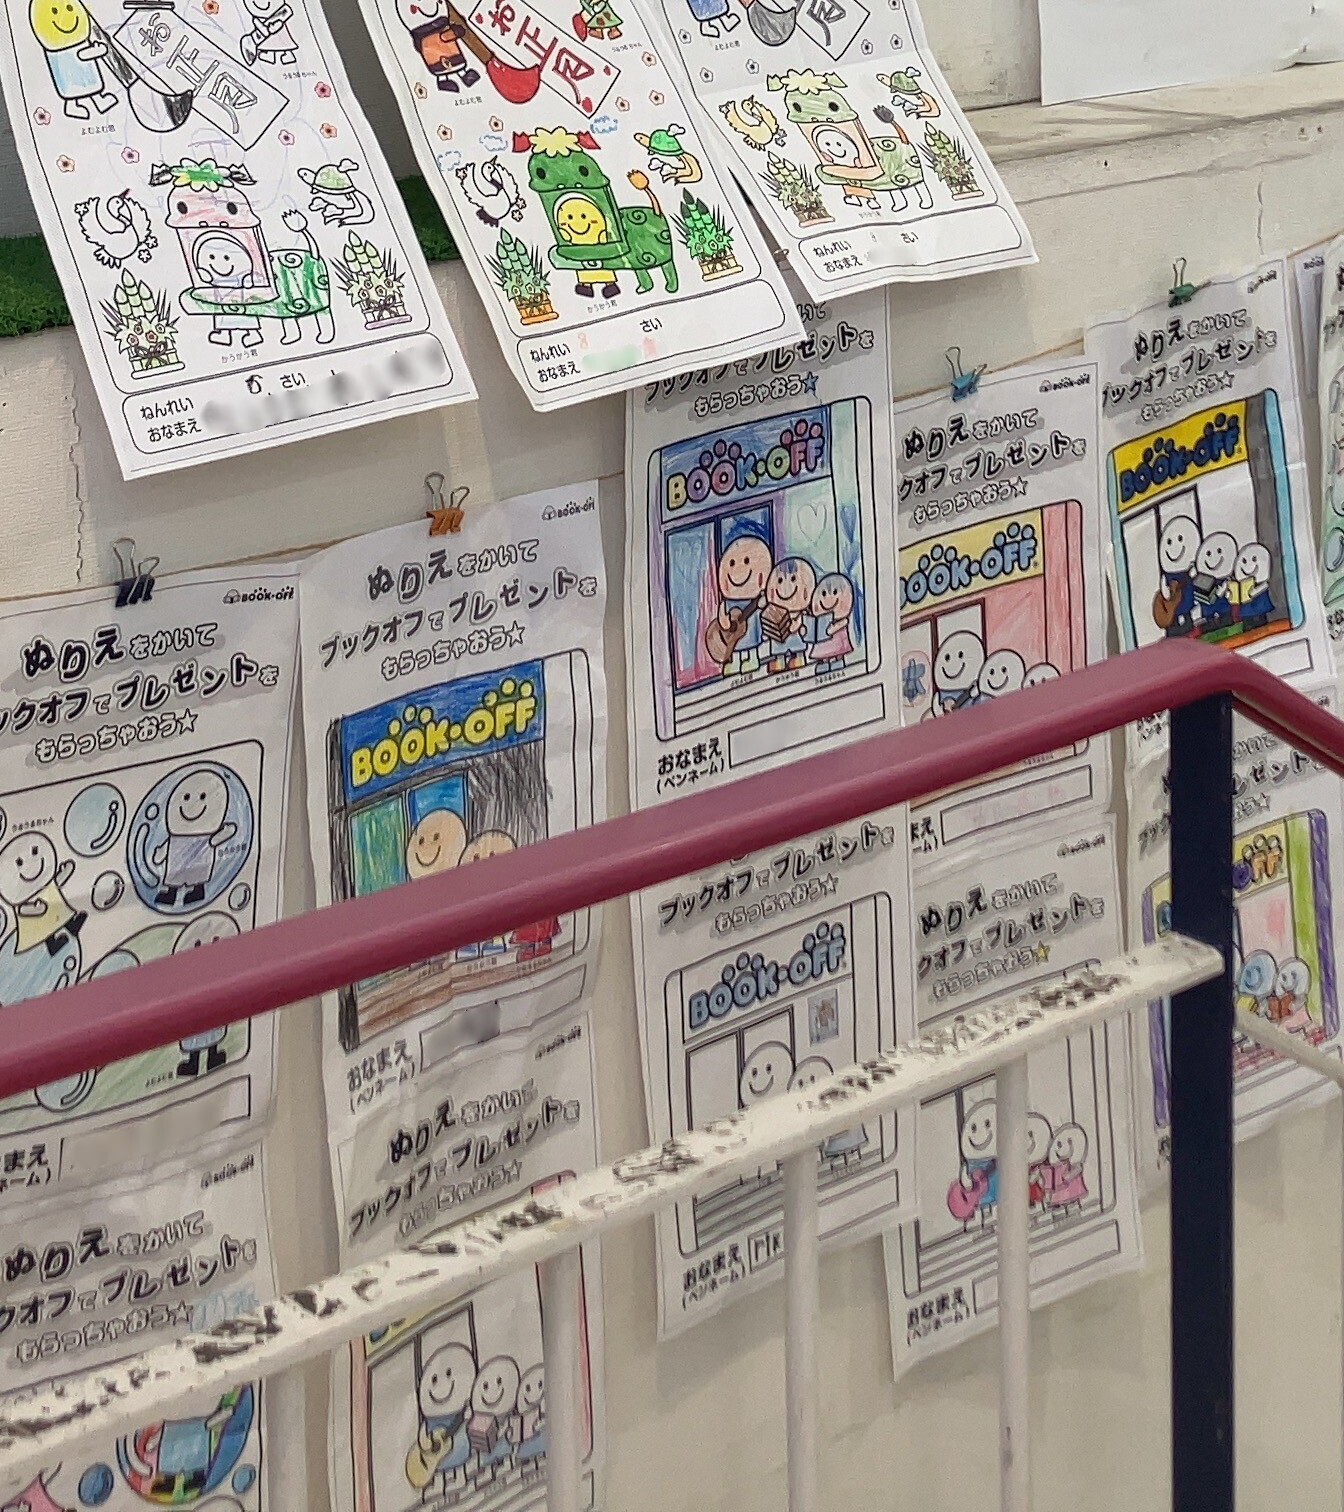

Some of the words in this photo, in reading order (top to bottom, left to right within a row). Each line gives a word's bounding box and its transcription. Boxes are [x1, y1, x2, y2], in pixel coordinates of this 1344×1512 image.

[138, 12, 257, 134] お正月
[639, 317, 663, 332] さい
[530, 341, 571, 362] ねんれい
[279, 373, 306, 389] さい
[536, 361, 581, 383] おなまえ
[140, 396, 194, 420] ねんれい
[147, 417, 202, 443] おなまえ
[904, 407, 1039, 461] ぬりえをかいて
[368, 538, 540, 603] ぬりえをかいて
[320, 568, 598, 669] ブックオフでプレゼントを
[21, 623, 218, 681] ぬりえをかいて
[657, 737, 722, 776] おなまえ
[347, 1039, 413, 1092] おなまえ
